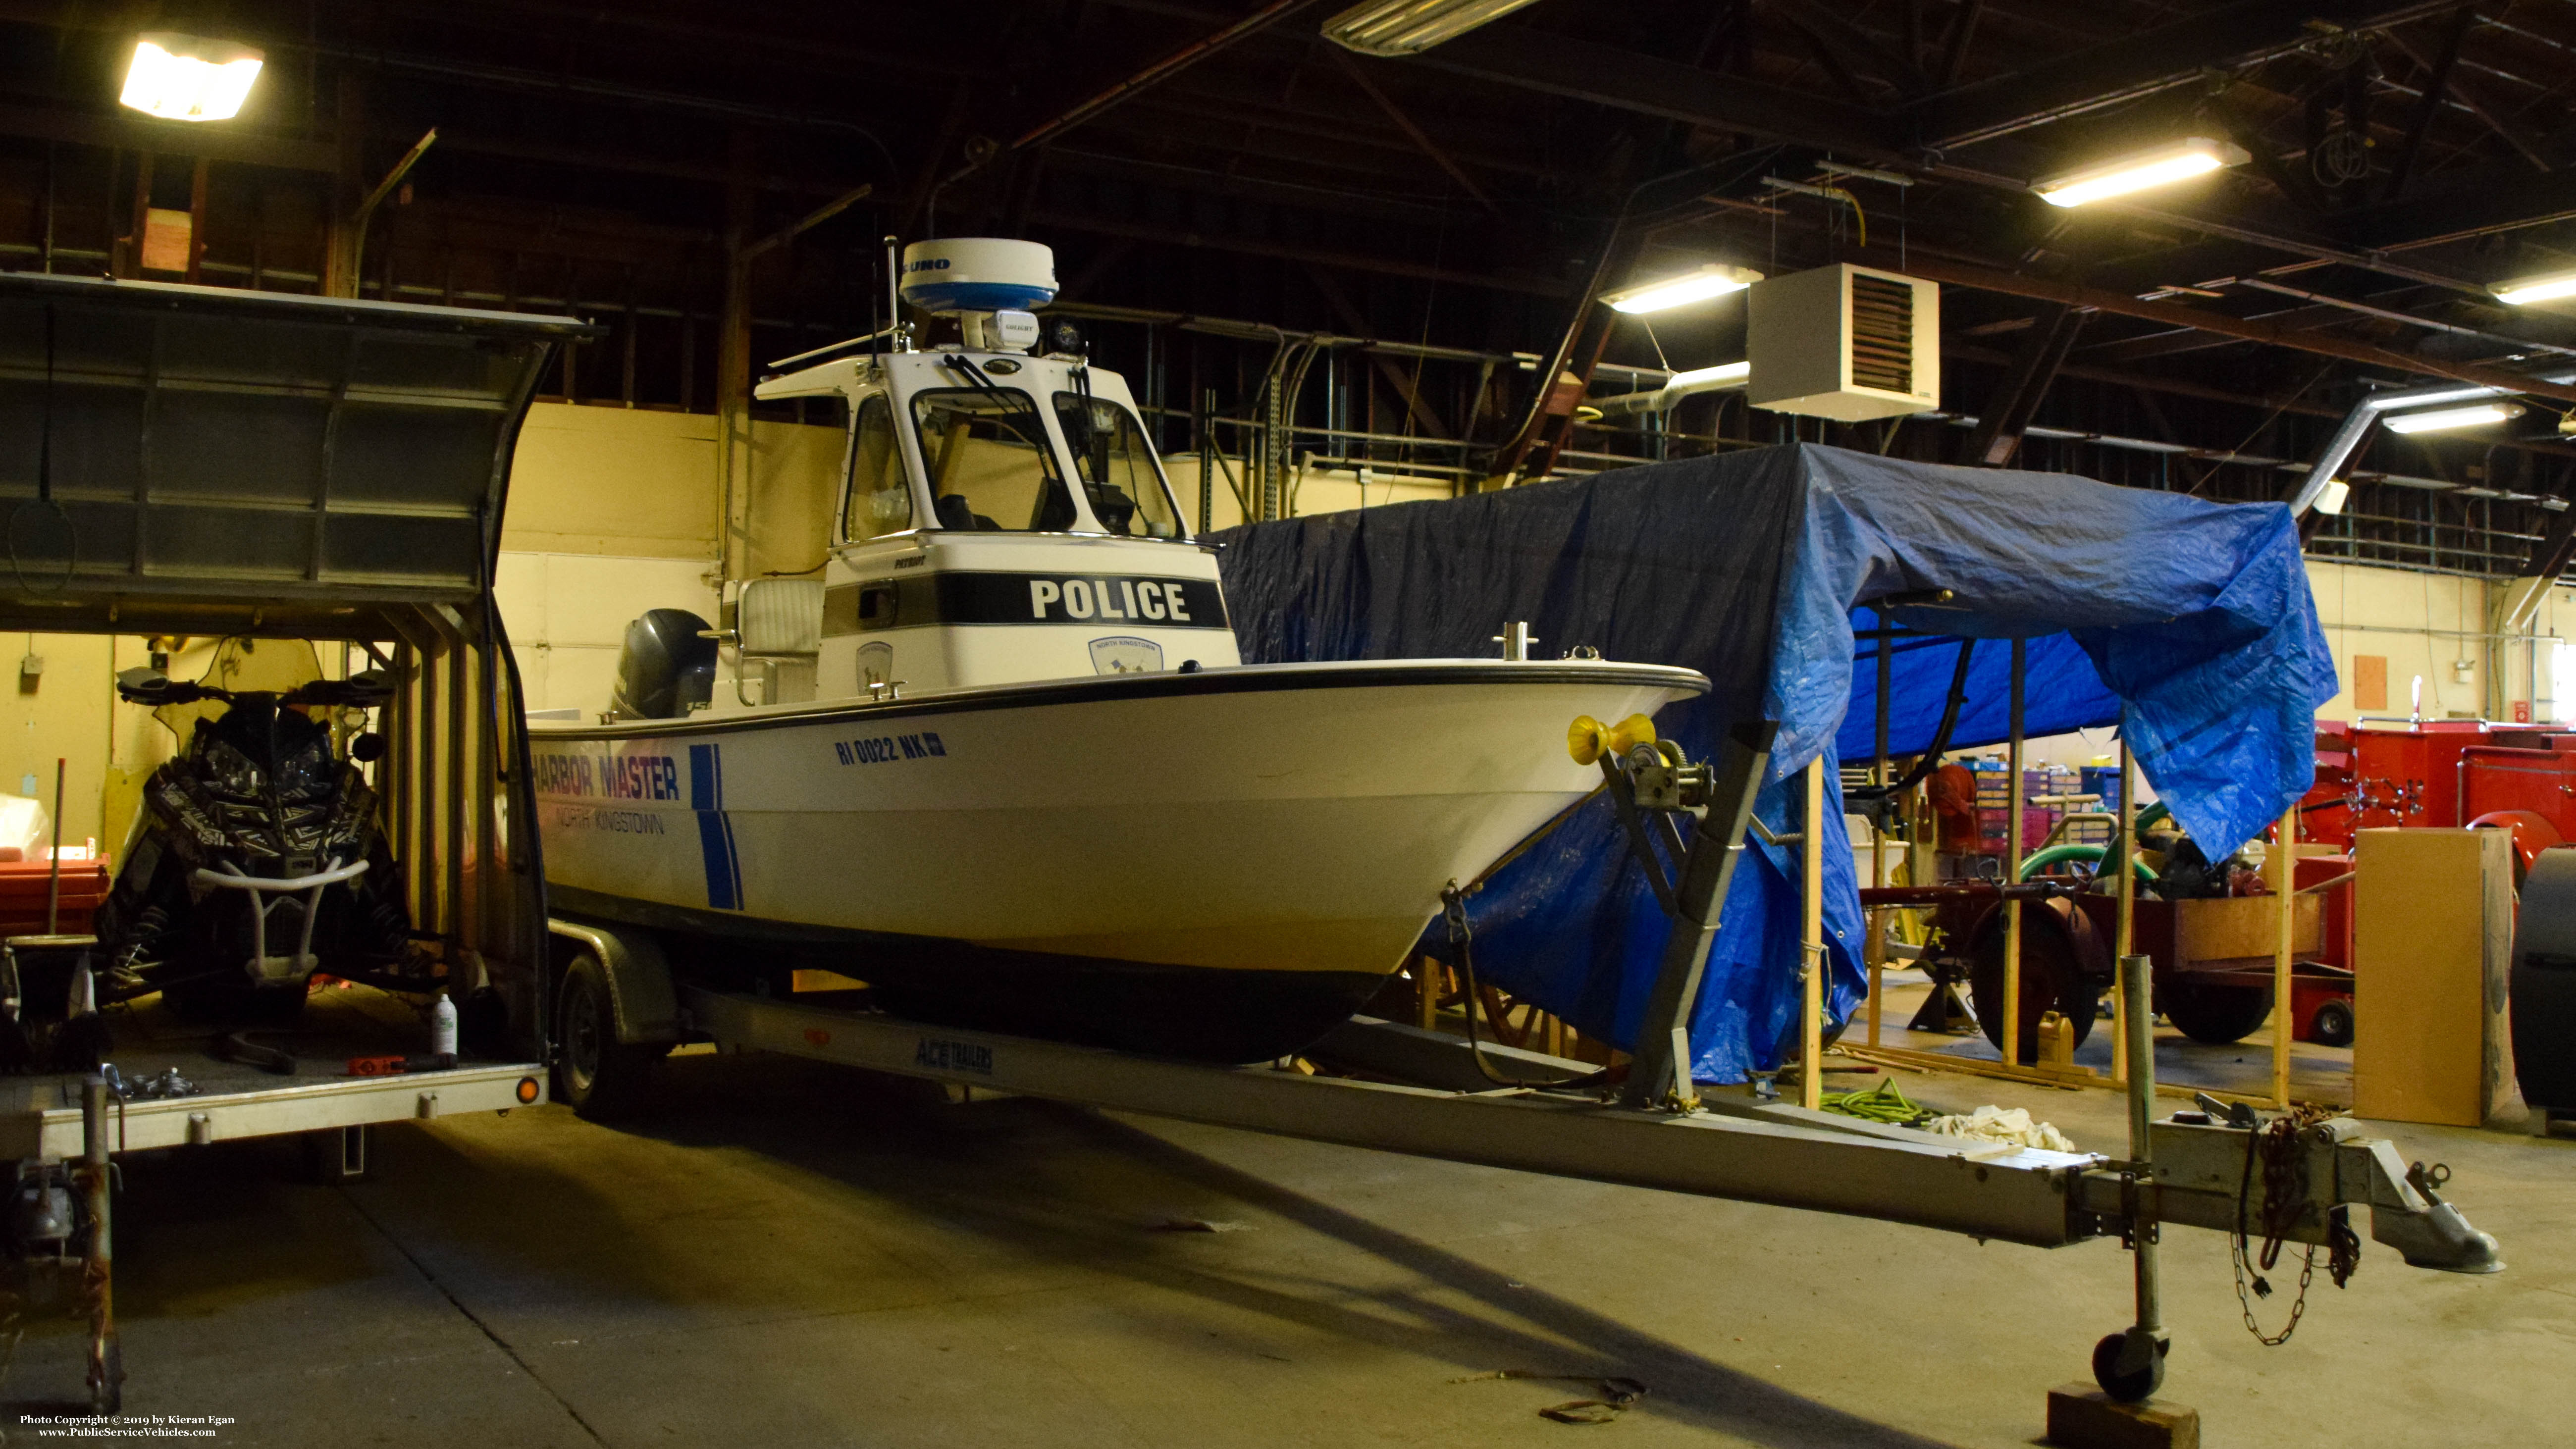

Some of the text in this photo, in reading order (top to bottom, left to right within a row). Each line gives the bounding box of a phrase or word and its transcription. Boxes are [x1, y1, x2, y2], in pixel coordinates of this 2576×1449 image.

[1030, 580, 1191, 621] POLICE
[1097, 640, 1156, 651] NORTH KINGSTOWN
[836, 734, 928, 765] RI 0022 NK
[598, 756, 679, 800] MASTER
[556, 808, 664, 834] NORTH KINGSTOWN
[916, 1037, 949, 1069] ACE
